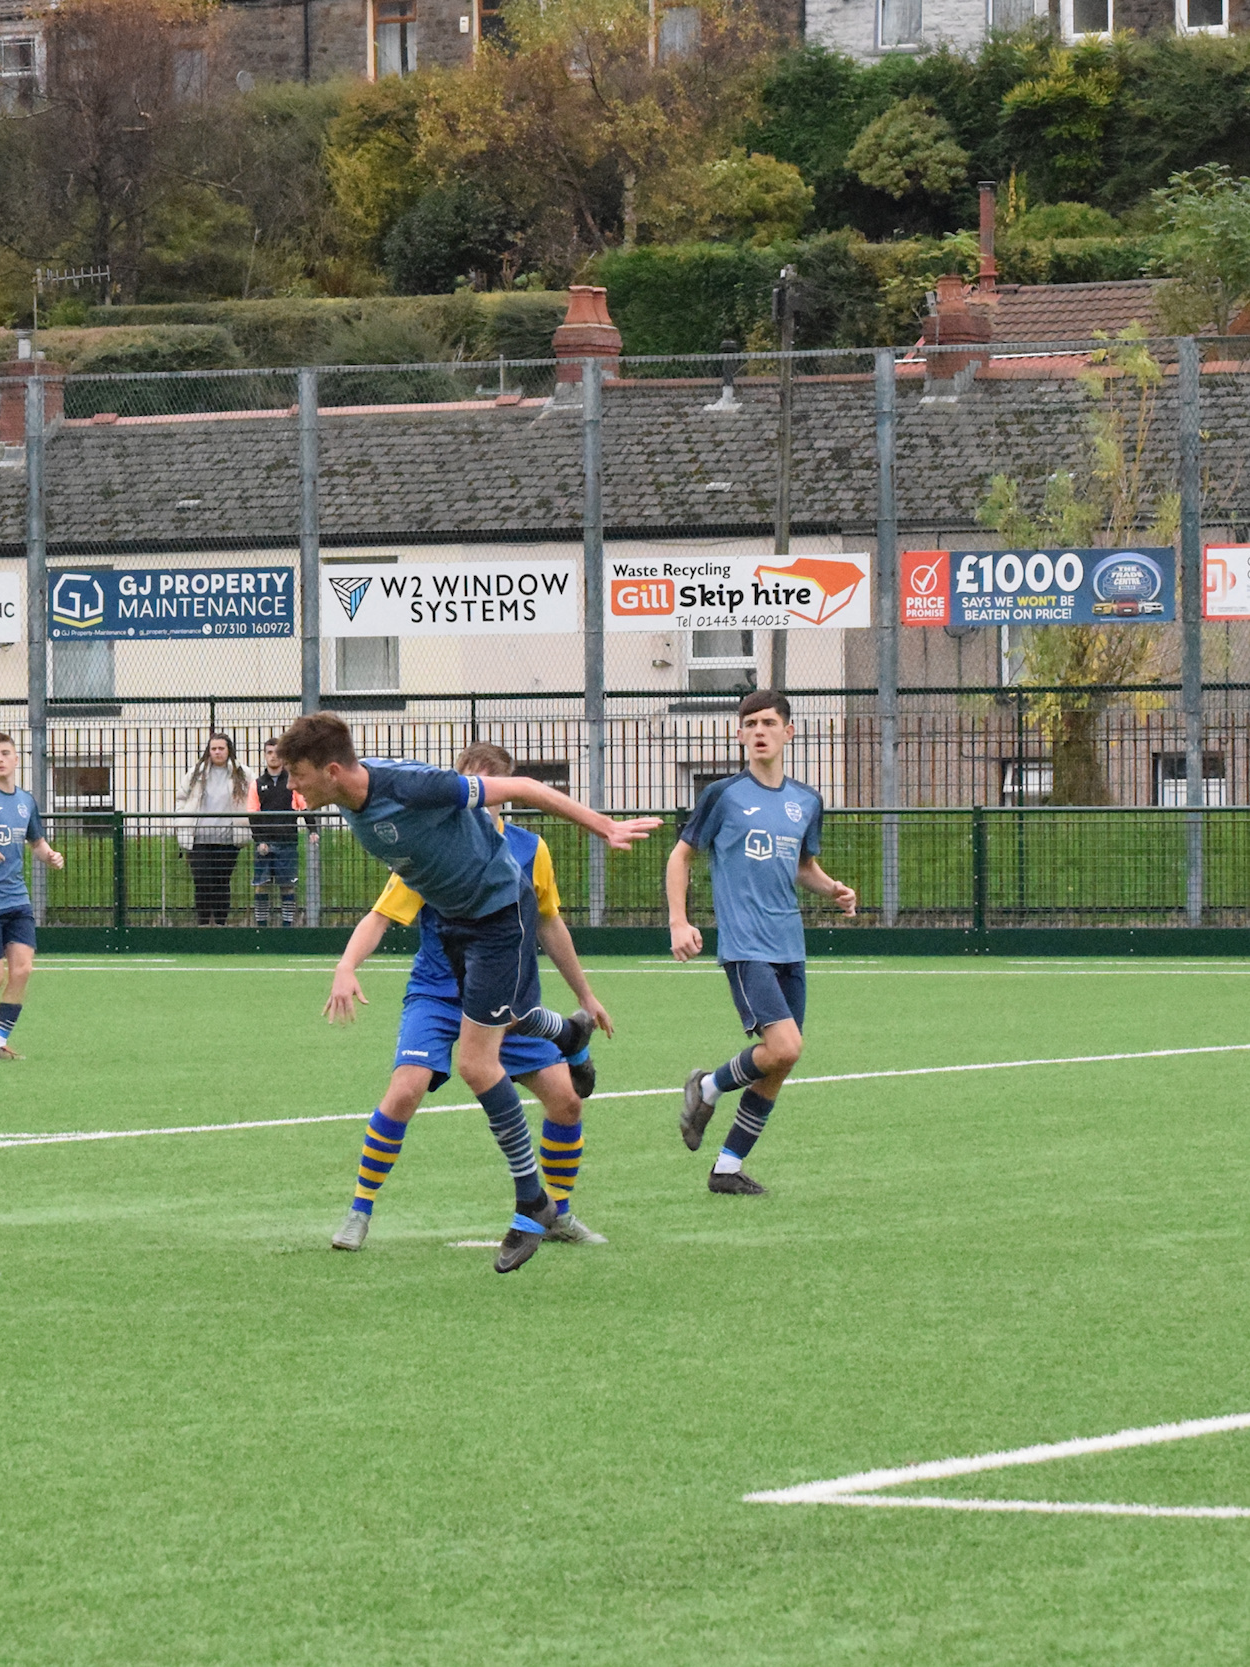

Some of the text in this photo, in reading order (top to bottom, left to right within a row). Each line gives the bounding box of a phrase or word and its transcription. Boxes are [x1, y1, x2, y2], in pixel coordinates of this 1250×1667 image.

[613, 562, 730, 578] Waste Recycling
[956, 553, 1083, 594] £1000
[119, 573, 288, 596] GJ PROPERTY
[380, 573, 569, 598] W2 WINDOW
[118, 596, 286, 618] MAINTENANCE
[617, 584, 670, 609] Gill
[680, 582, 811, 613] Skip hire
[906, 597, 944, 608] PRICE
[962, 595, 1074, 608] SAYS WE WON'T BE
[411, 599, 536, 623] SYSTEMS
[676, 614, 790, 627] Tel 01443 440015
[965, 608, 1072, 620] BEATEN ON PRICE!
[215, 622, 290, 635] 07310 160972
